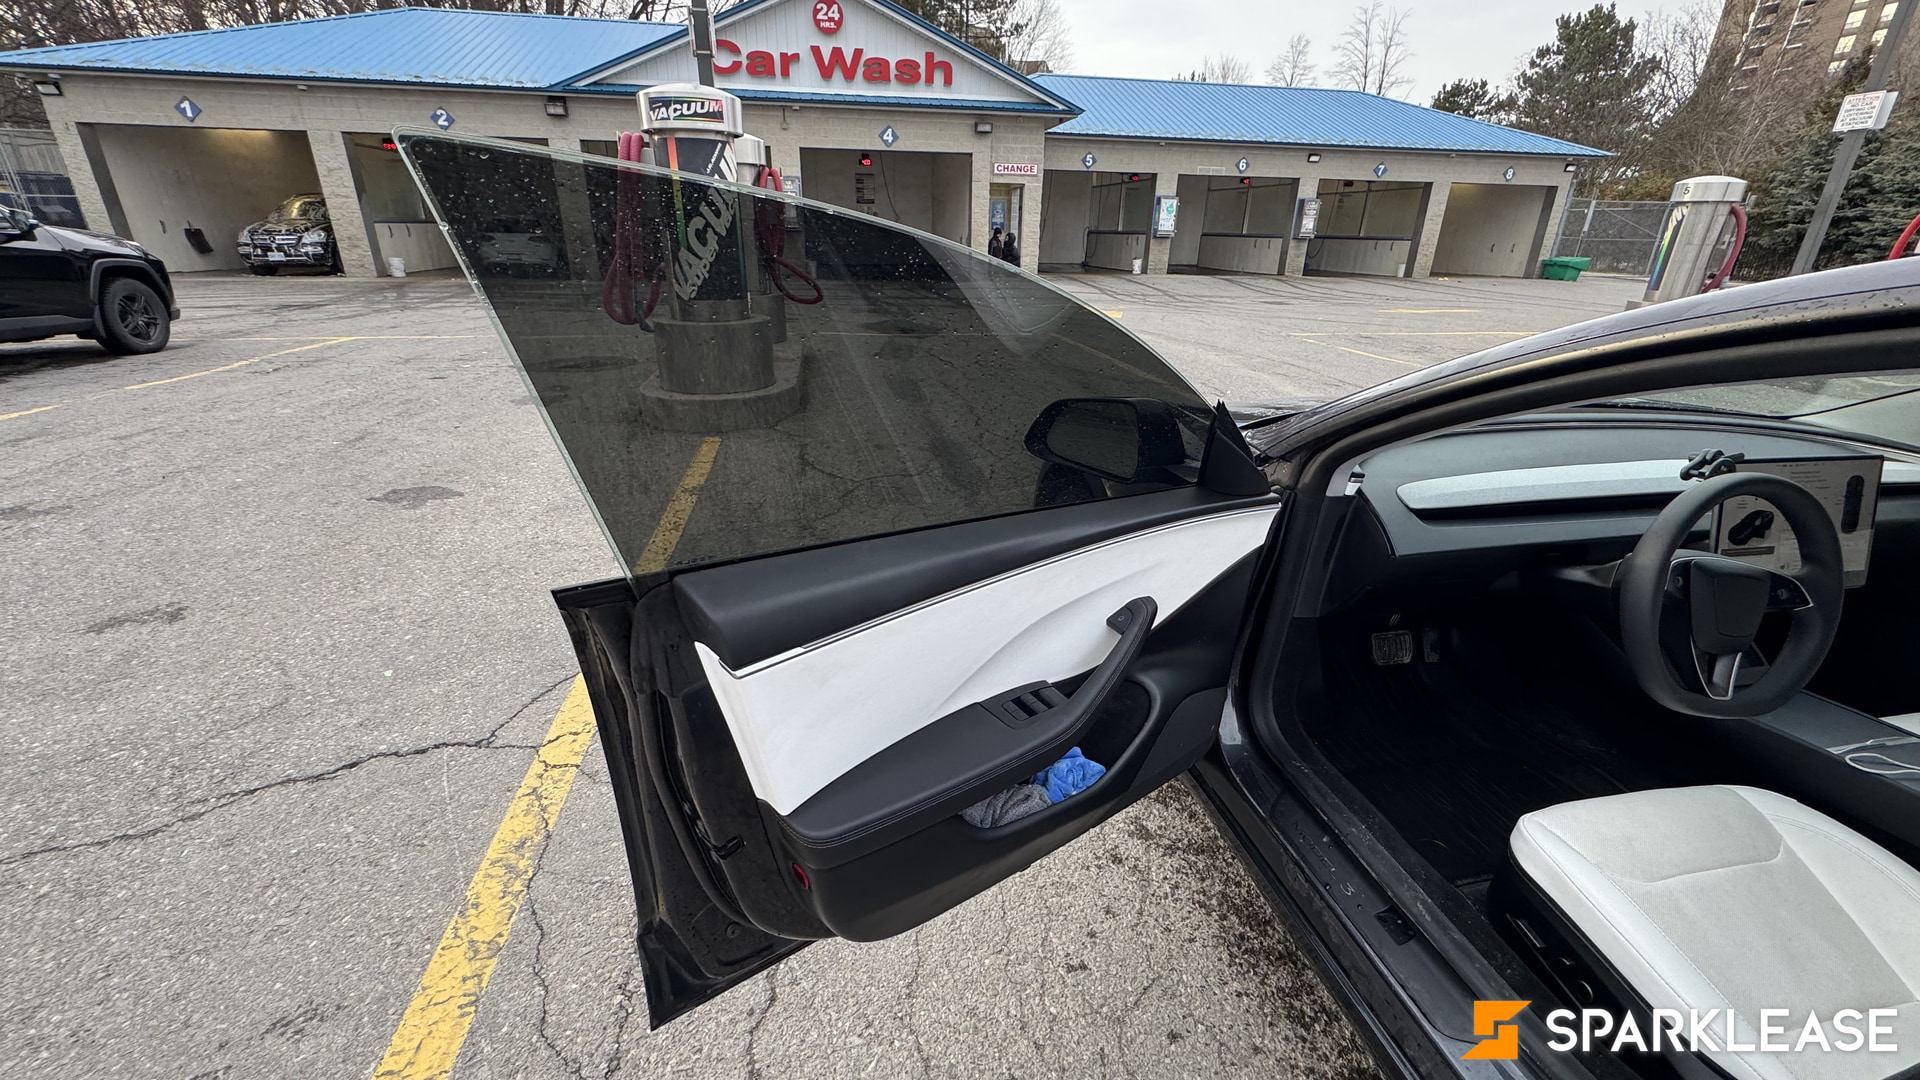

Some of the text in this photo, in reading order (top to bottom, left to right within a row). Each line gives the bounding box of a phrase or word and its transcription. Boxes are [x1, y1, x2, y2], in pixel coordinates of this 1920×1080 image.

[816, 3, 840, 20] 24
[713, 38, 953, 86] Car Wash
[180, 100, 193, 117] 1
[649, 101, 723, 121] VACUUM
[436, 109, 449, 126] 2
[882, 128, 893, 143] 4
[1085, 154, 1093, 166] 5
[1239, 158, 1247, 170] 6
[996, 164, 1036, 173] CHANGE
[1378, 165, 1385, 176] 7
[1505, 168, 1514, 180] 8
[1683, 186, 1691, 195] 5
